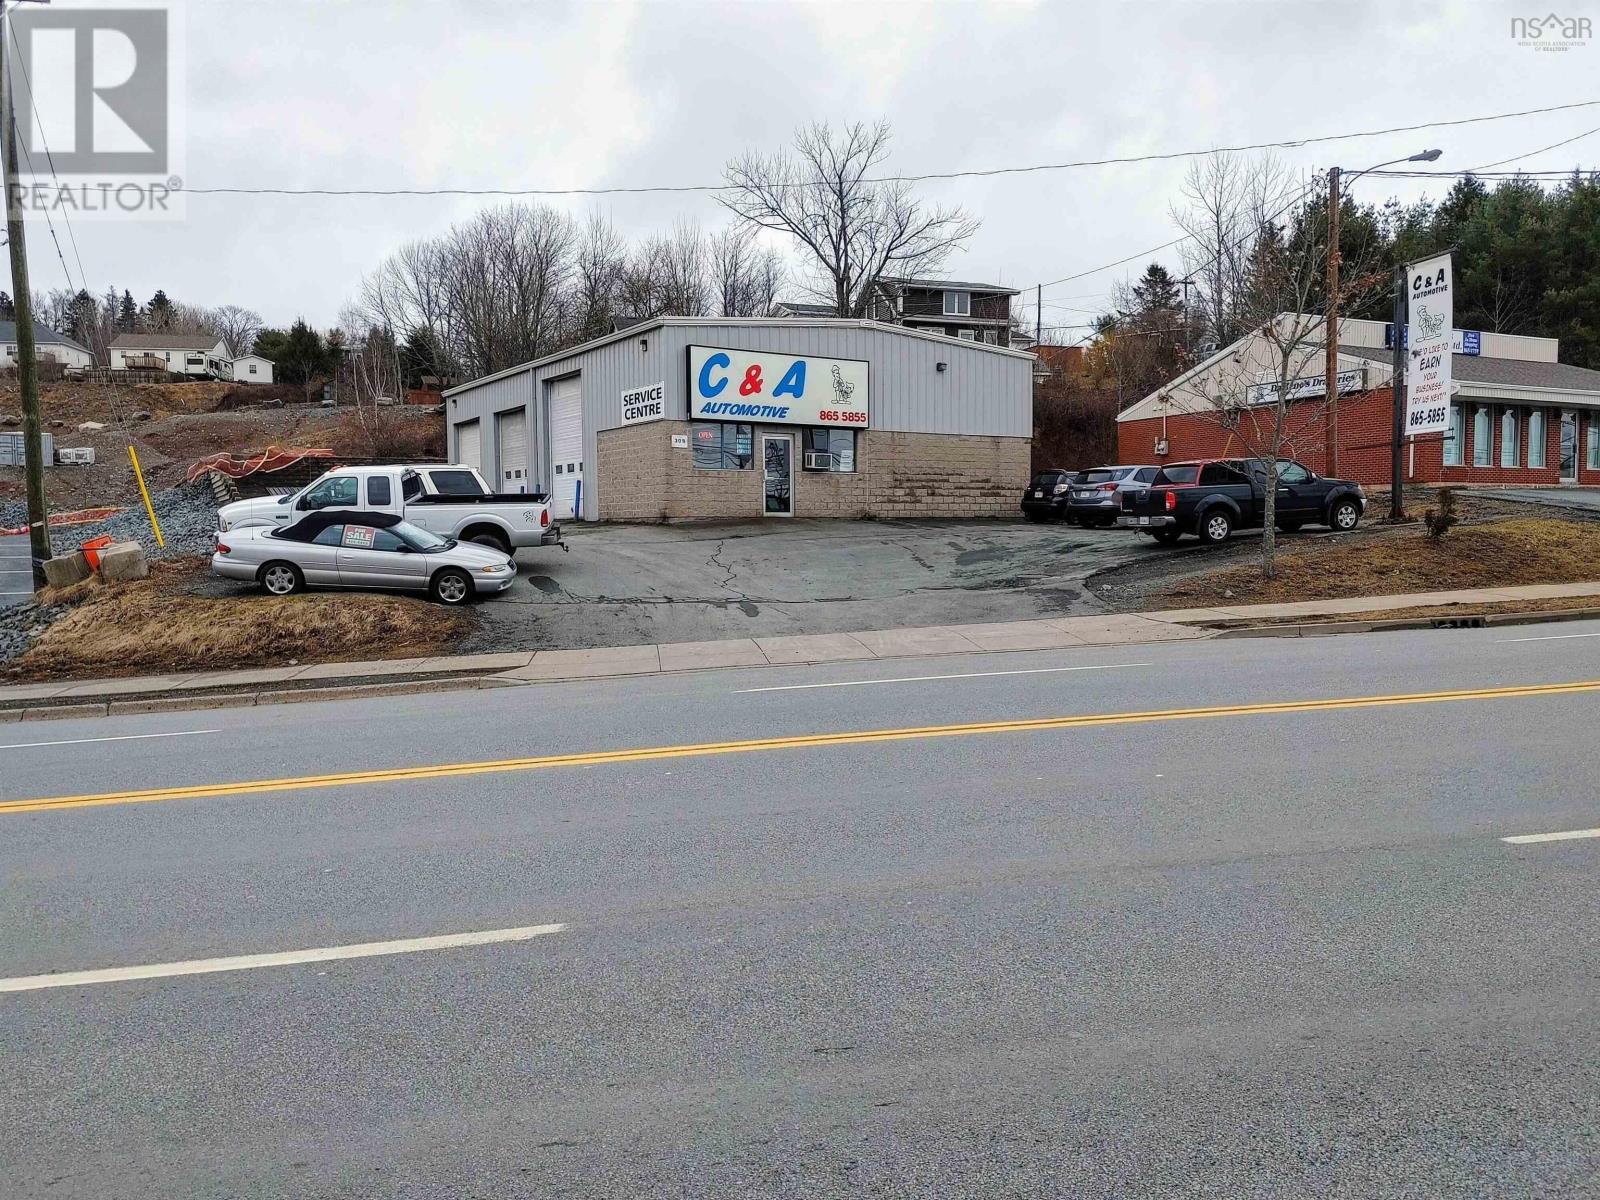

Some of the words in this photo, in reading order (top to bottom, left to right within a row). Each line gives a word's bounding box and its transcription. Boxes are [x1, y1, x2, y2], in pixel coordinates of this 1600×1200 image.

[1413, 275, 1422, 290] C
[1425, 276, 1432, 288] &
[1435, 268, 1445, 285] A
[1412, 284, 1448, 300] AUTOMOTIVE
[1420, 354, 1442, 371] EARN
[698, 352, 730, 398] C
[739, 364, 763, 396] &
[772, 360, 807, 398] A
[623, 386, 663, 407] SERVICE
[624, 401, 662, 420] CENTRE
[700, 401, 790, 418] AUTOMOTIVE
[819, 410, 839, 421] 865
[841, 411, 866, 422] 5855
[1410, 407, 1446, 427] 865-5855
[346, 531, 372, 541] SALE
